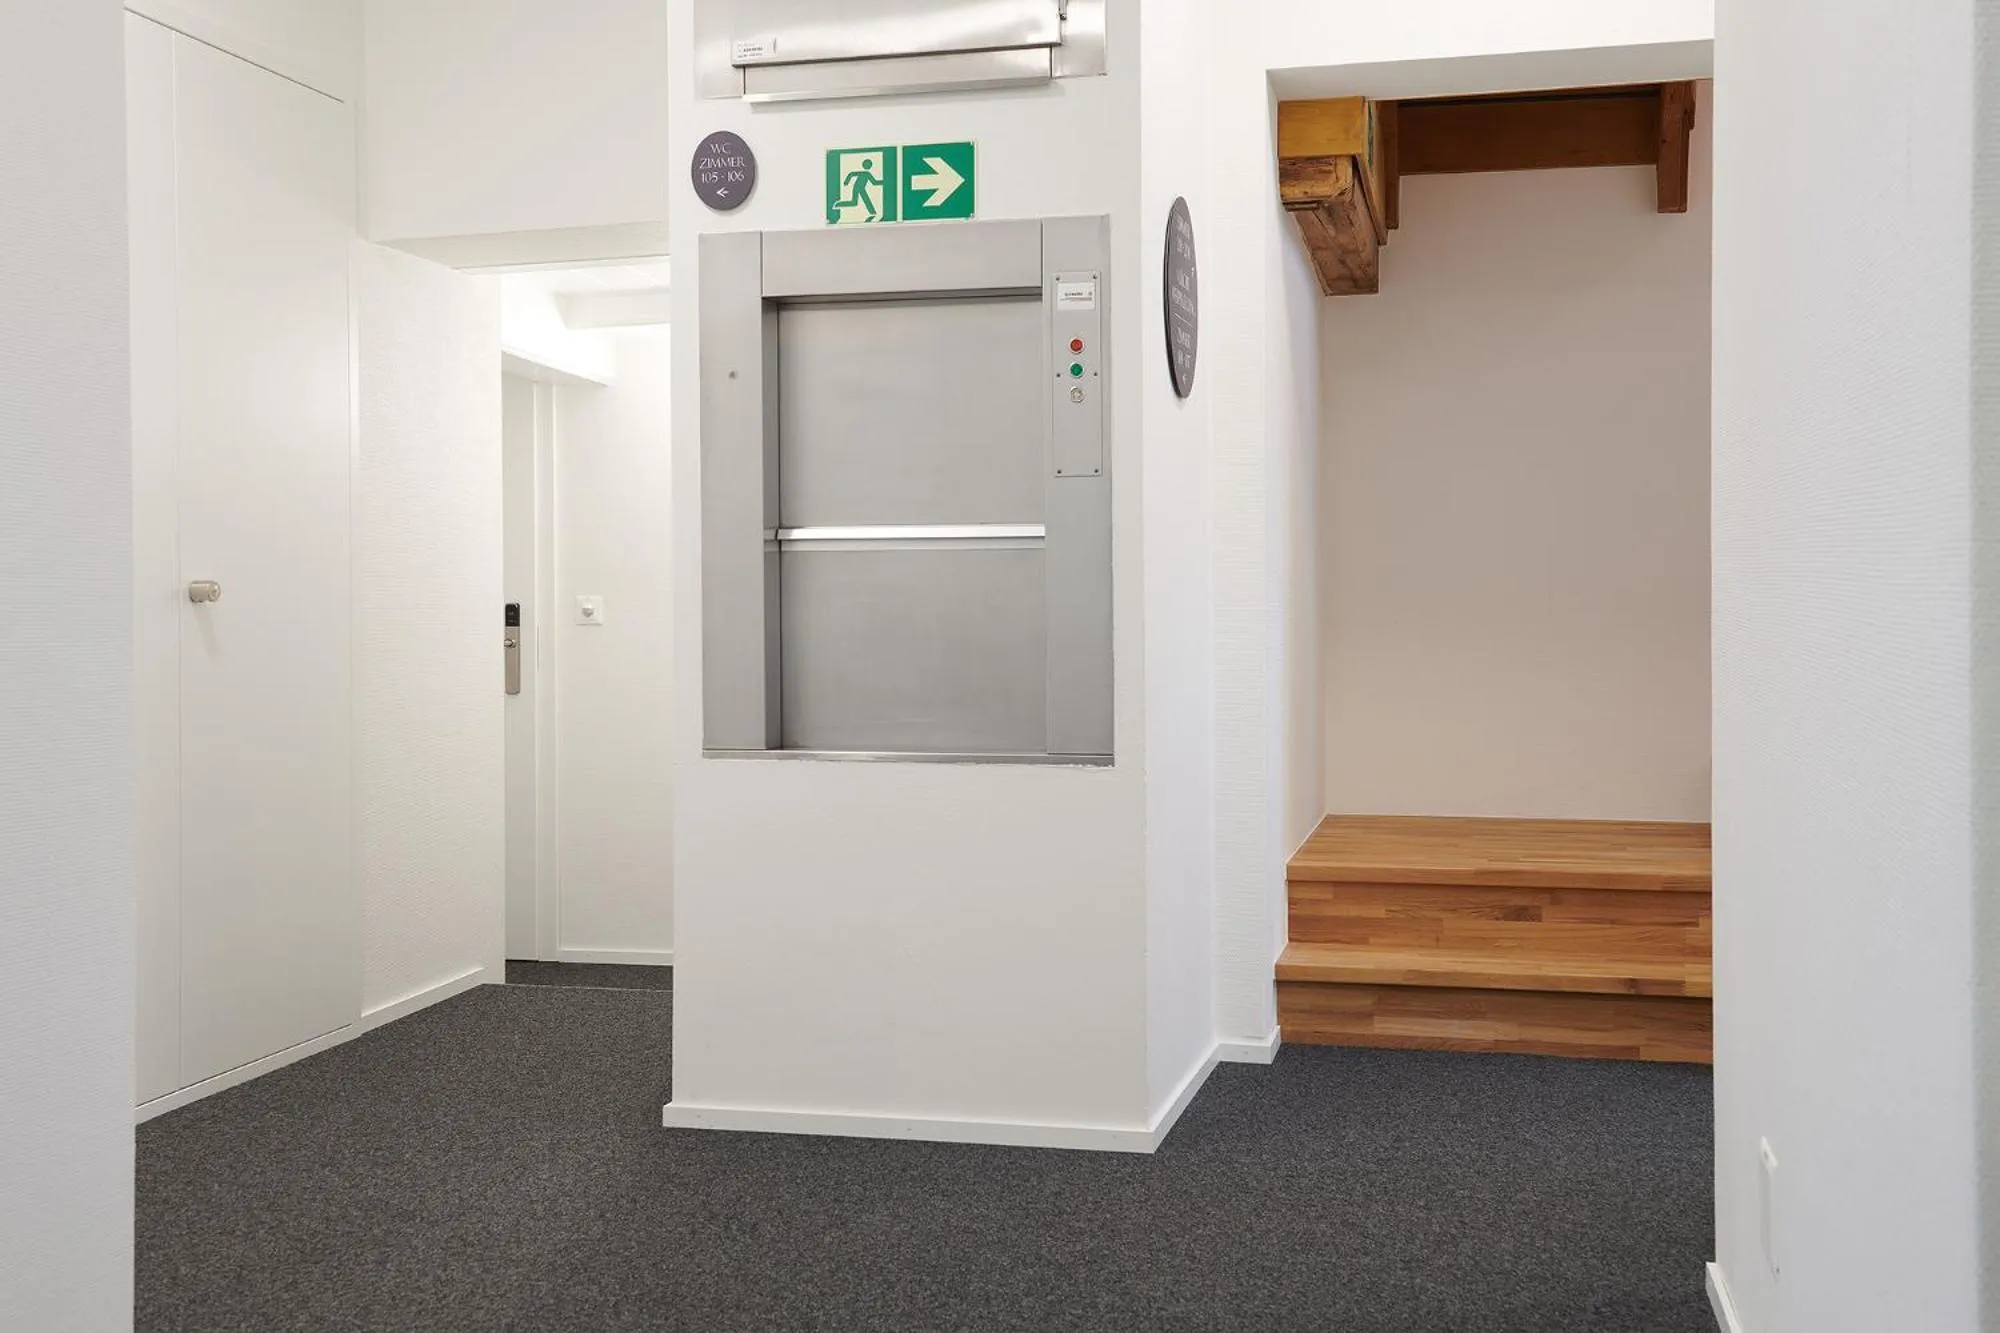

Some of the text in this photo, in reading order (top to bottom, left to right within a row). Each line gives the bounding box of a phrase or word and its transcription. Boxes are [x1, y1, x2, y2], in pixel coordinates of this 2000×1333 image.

[711, 143, 730, 154] WC
[699, 157, 745, 169] ZIMMER
[727, 170, 745, 183] 106
